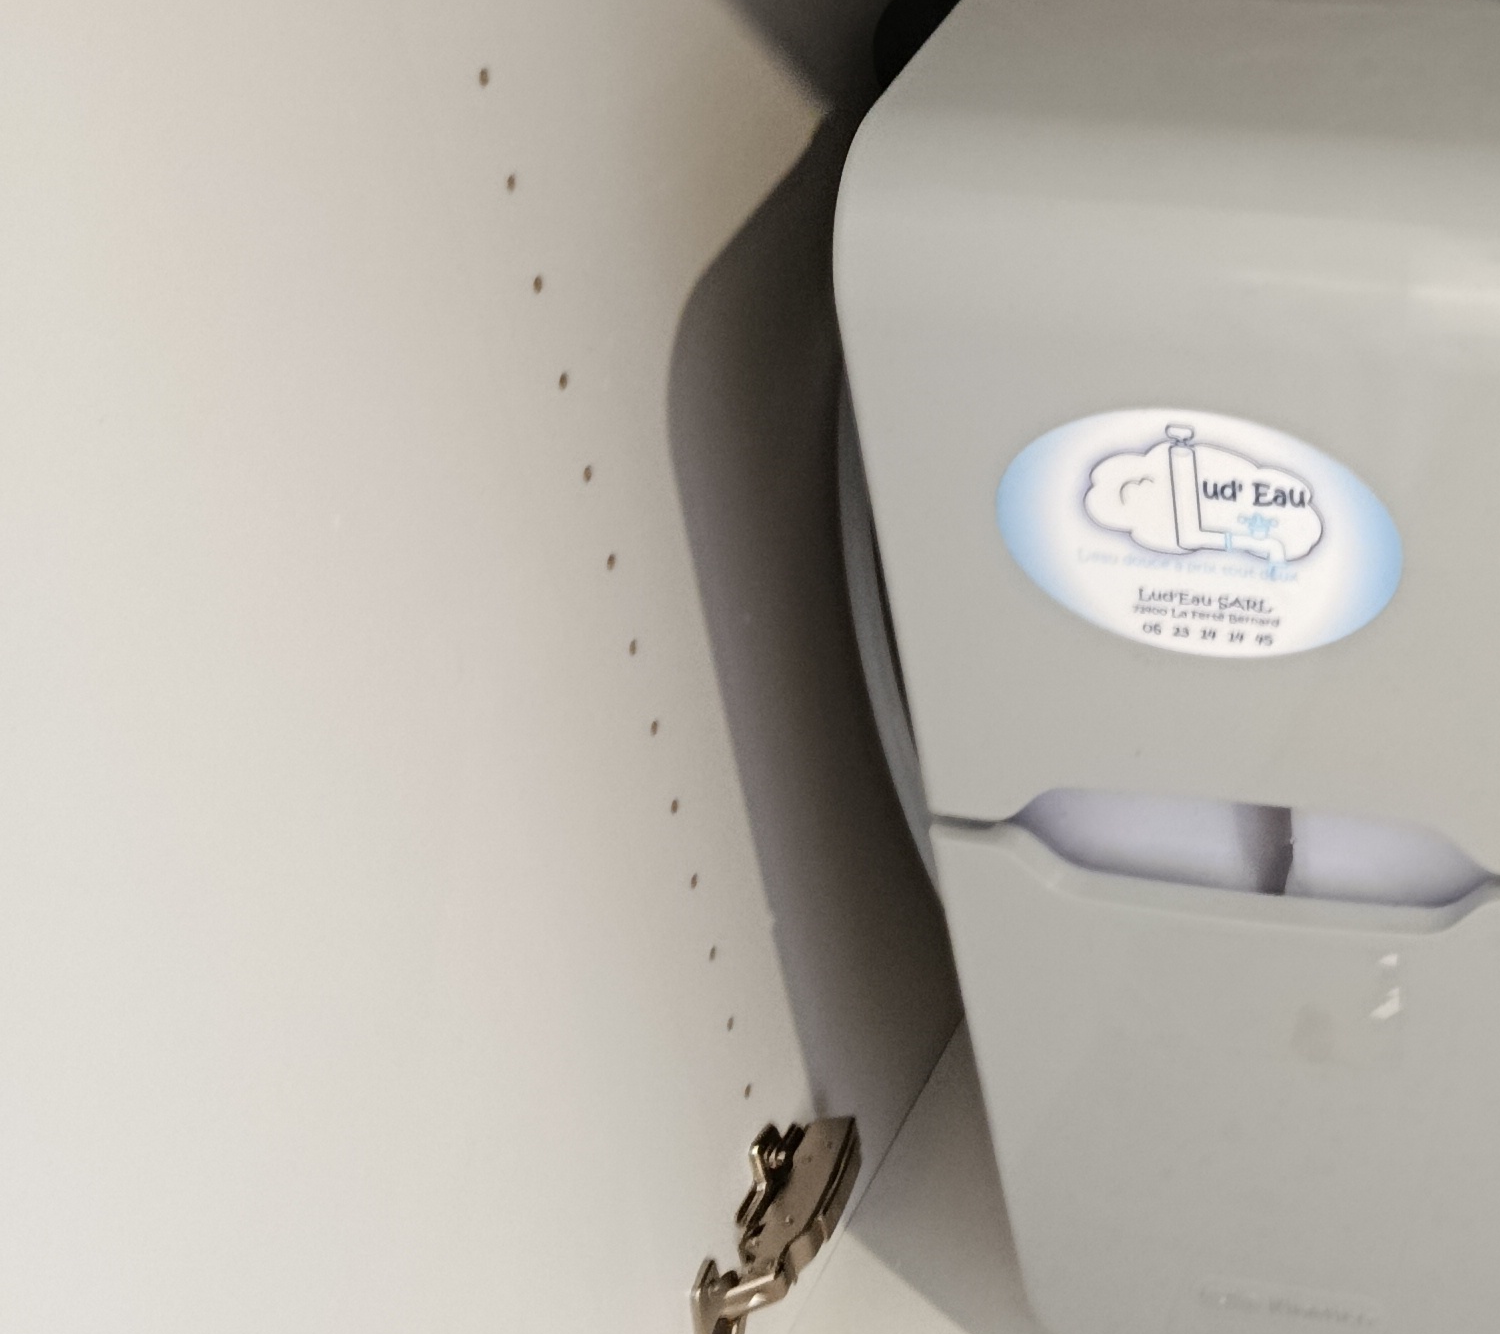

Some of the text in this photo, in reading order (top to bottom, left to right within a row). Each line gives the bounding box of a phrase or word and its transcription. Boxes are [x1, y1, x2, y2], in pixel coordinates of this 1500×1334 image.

[1253, 482, 1307, 509] Eau
[1171, 608, 1188, 620] La
[1228, 614, 1281, 628] Bernard
